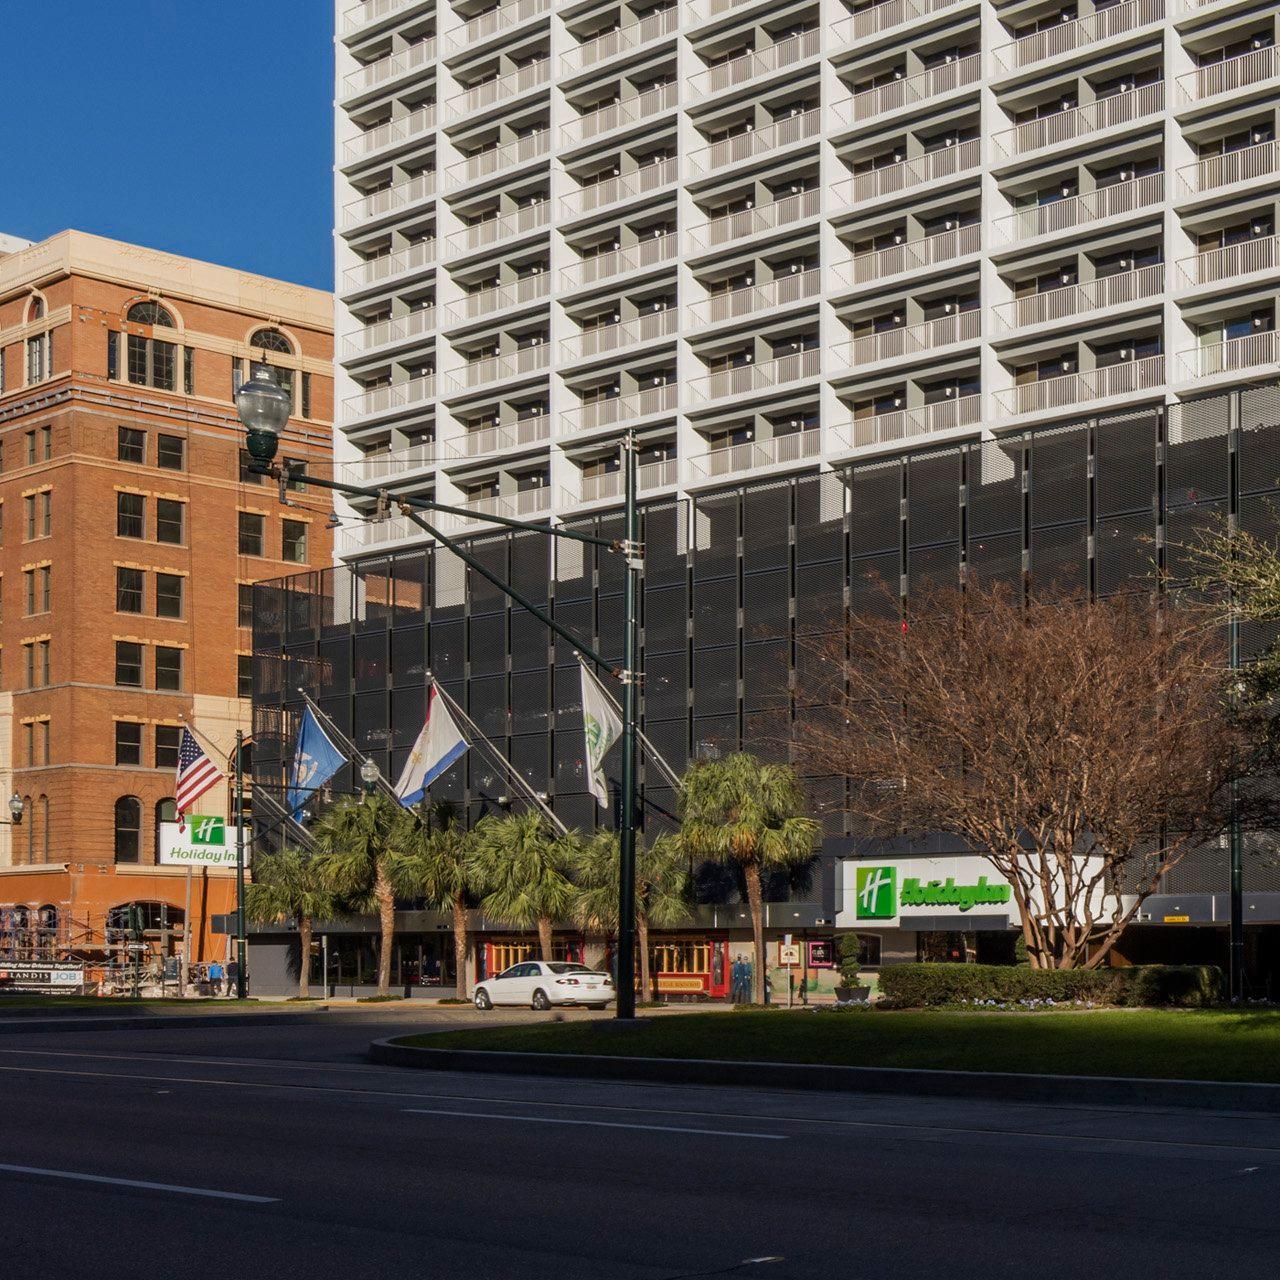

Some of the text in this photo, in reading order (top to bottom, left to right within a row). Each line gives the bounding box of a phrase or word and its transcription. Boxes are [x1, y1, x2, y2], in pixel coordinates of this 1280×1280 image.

[170, 847, 222, 863] Holiday
[900, 876, 1011, 912] Holiday Inn
[53, 972, 77, 980] JOB
